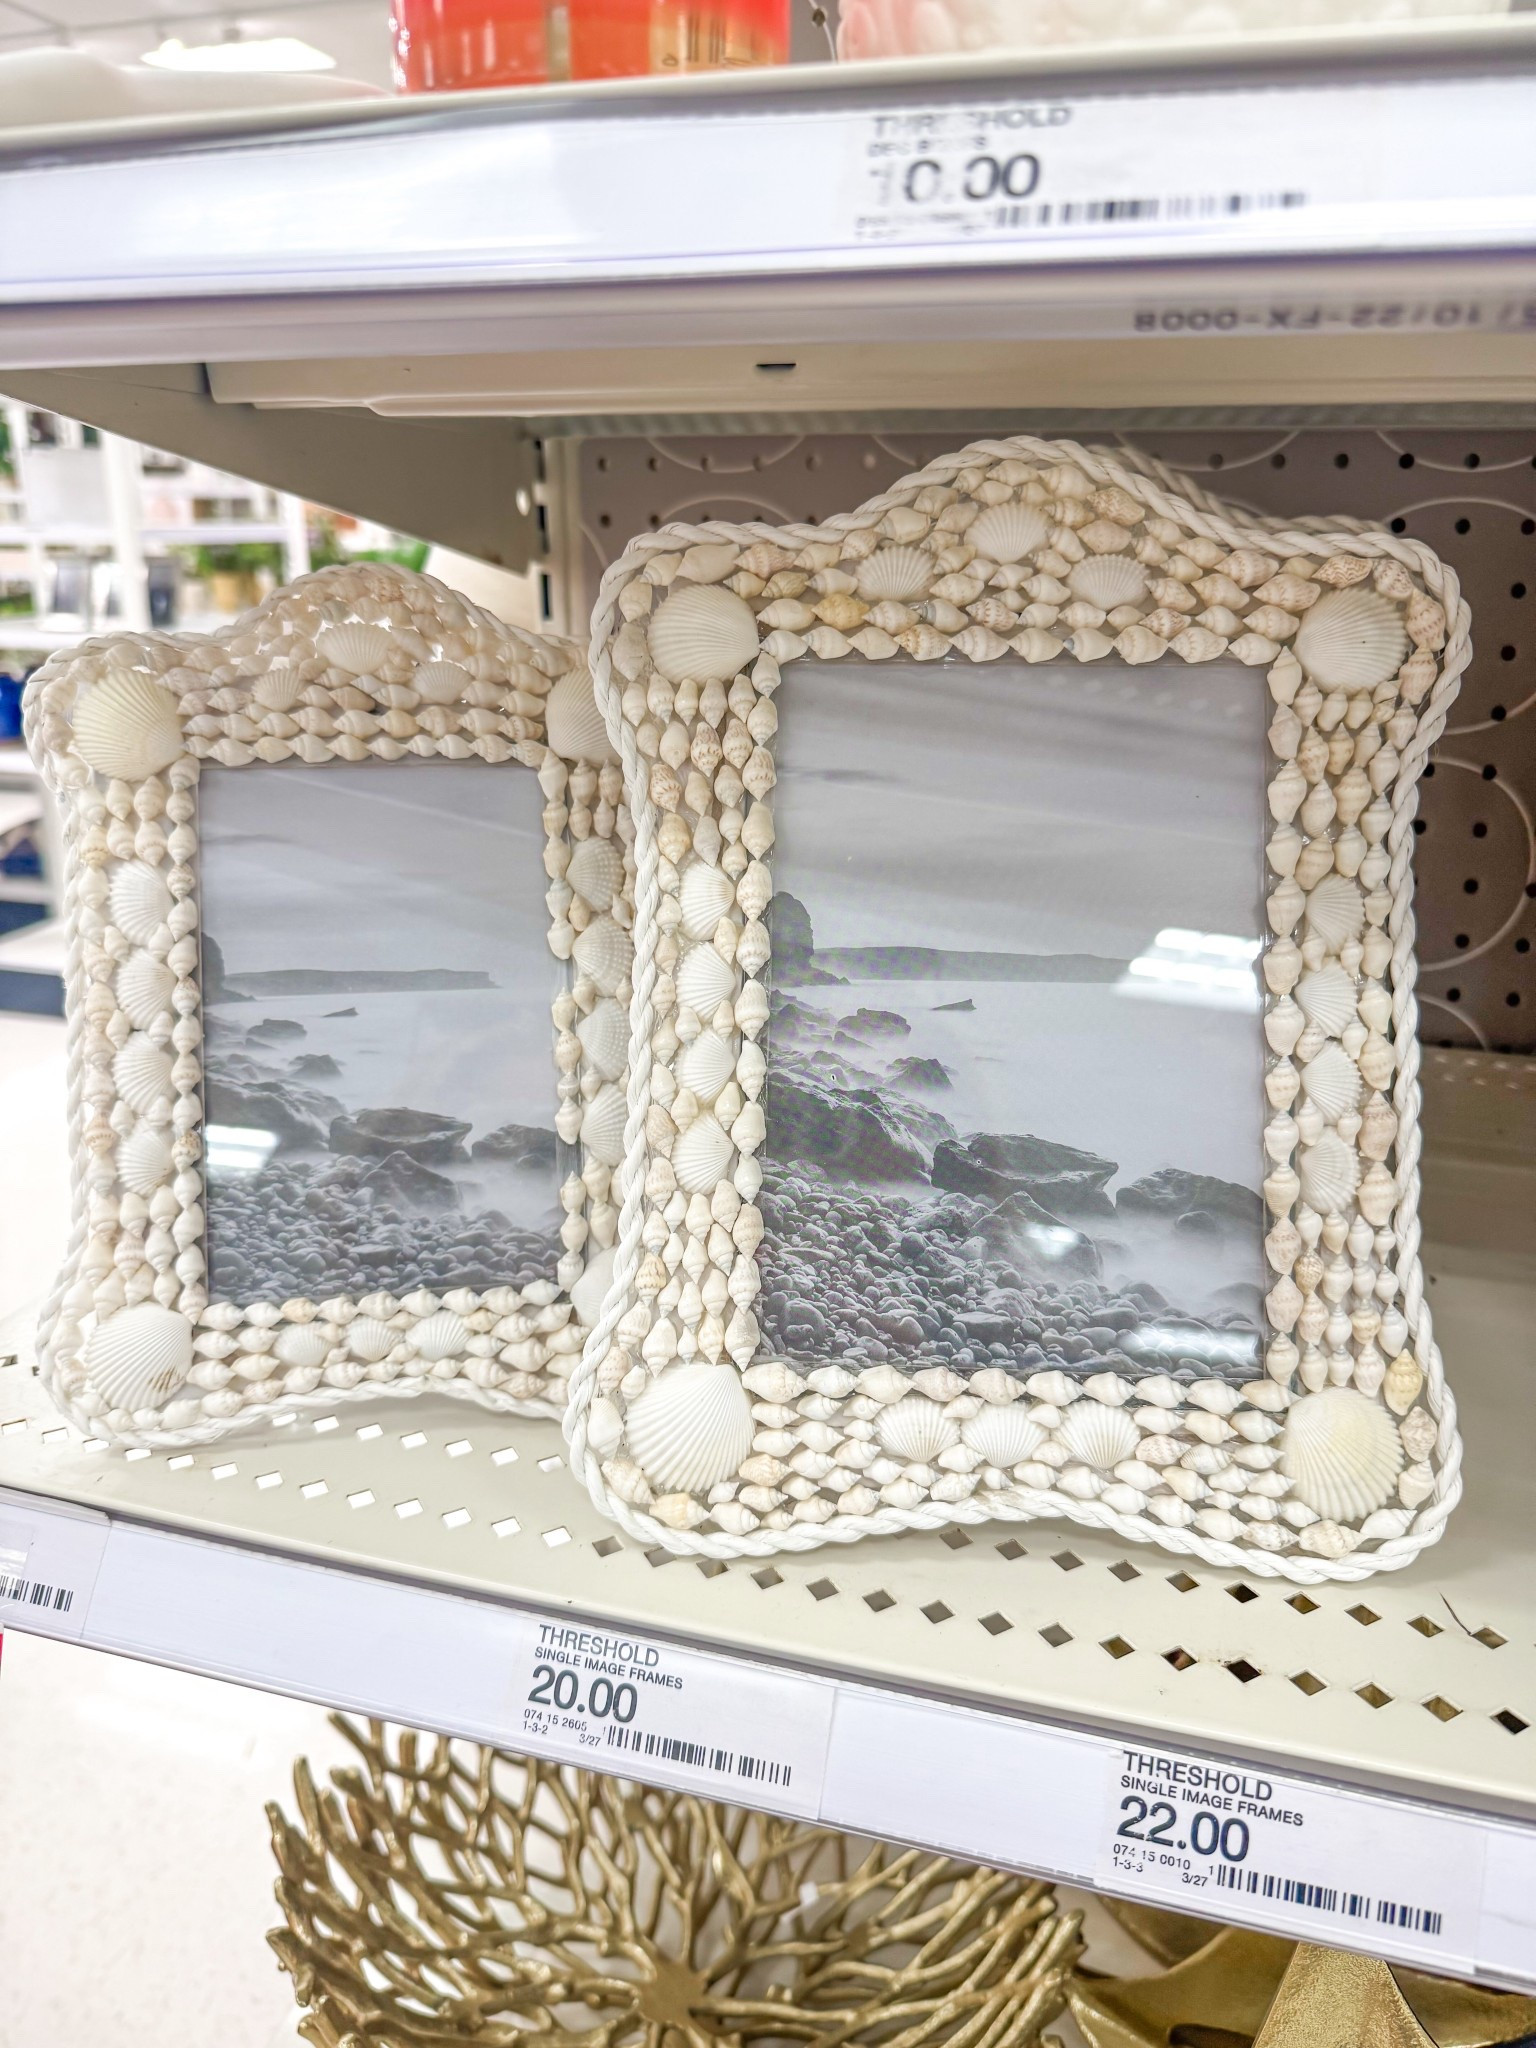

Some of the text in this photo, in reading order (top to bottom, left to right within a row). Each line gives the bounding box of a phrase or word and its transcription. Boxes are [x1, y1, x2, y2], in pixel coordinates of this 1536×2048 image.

[873, 104, 1073, 138] THRHOLD
[539, 1623, 660, 1667] THRESHOLD
[534, 1646, 684, 1689] SINGLE IMAGE FRAMES
[527, 1664, 638, 1723] 20.00
[523, 1720, 602, 1747] 1-3-2 3/27
[524, 1708, 543, 1721] 074
[547, 1713, 559, 1725] 15
[561, 1717, 588, 1732] 2605
[1123, 1750, 1273, 1801] THRESHOLD
[1120, 1775, 1304, 1827] SINGLE IMAGE FRAMES
[1116, 1795, 1250, 1862] 22.00
[1112, 1856, 1208, 1887] 1-3-3 3/27
[1113, 1843, 1136, 1858] 074
[1141, 1850, 1156, 1862] 15
[1159, 1854, 1191, 1870] 0010
